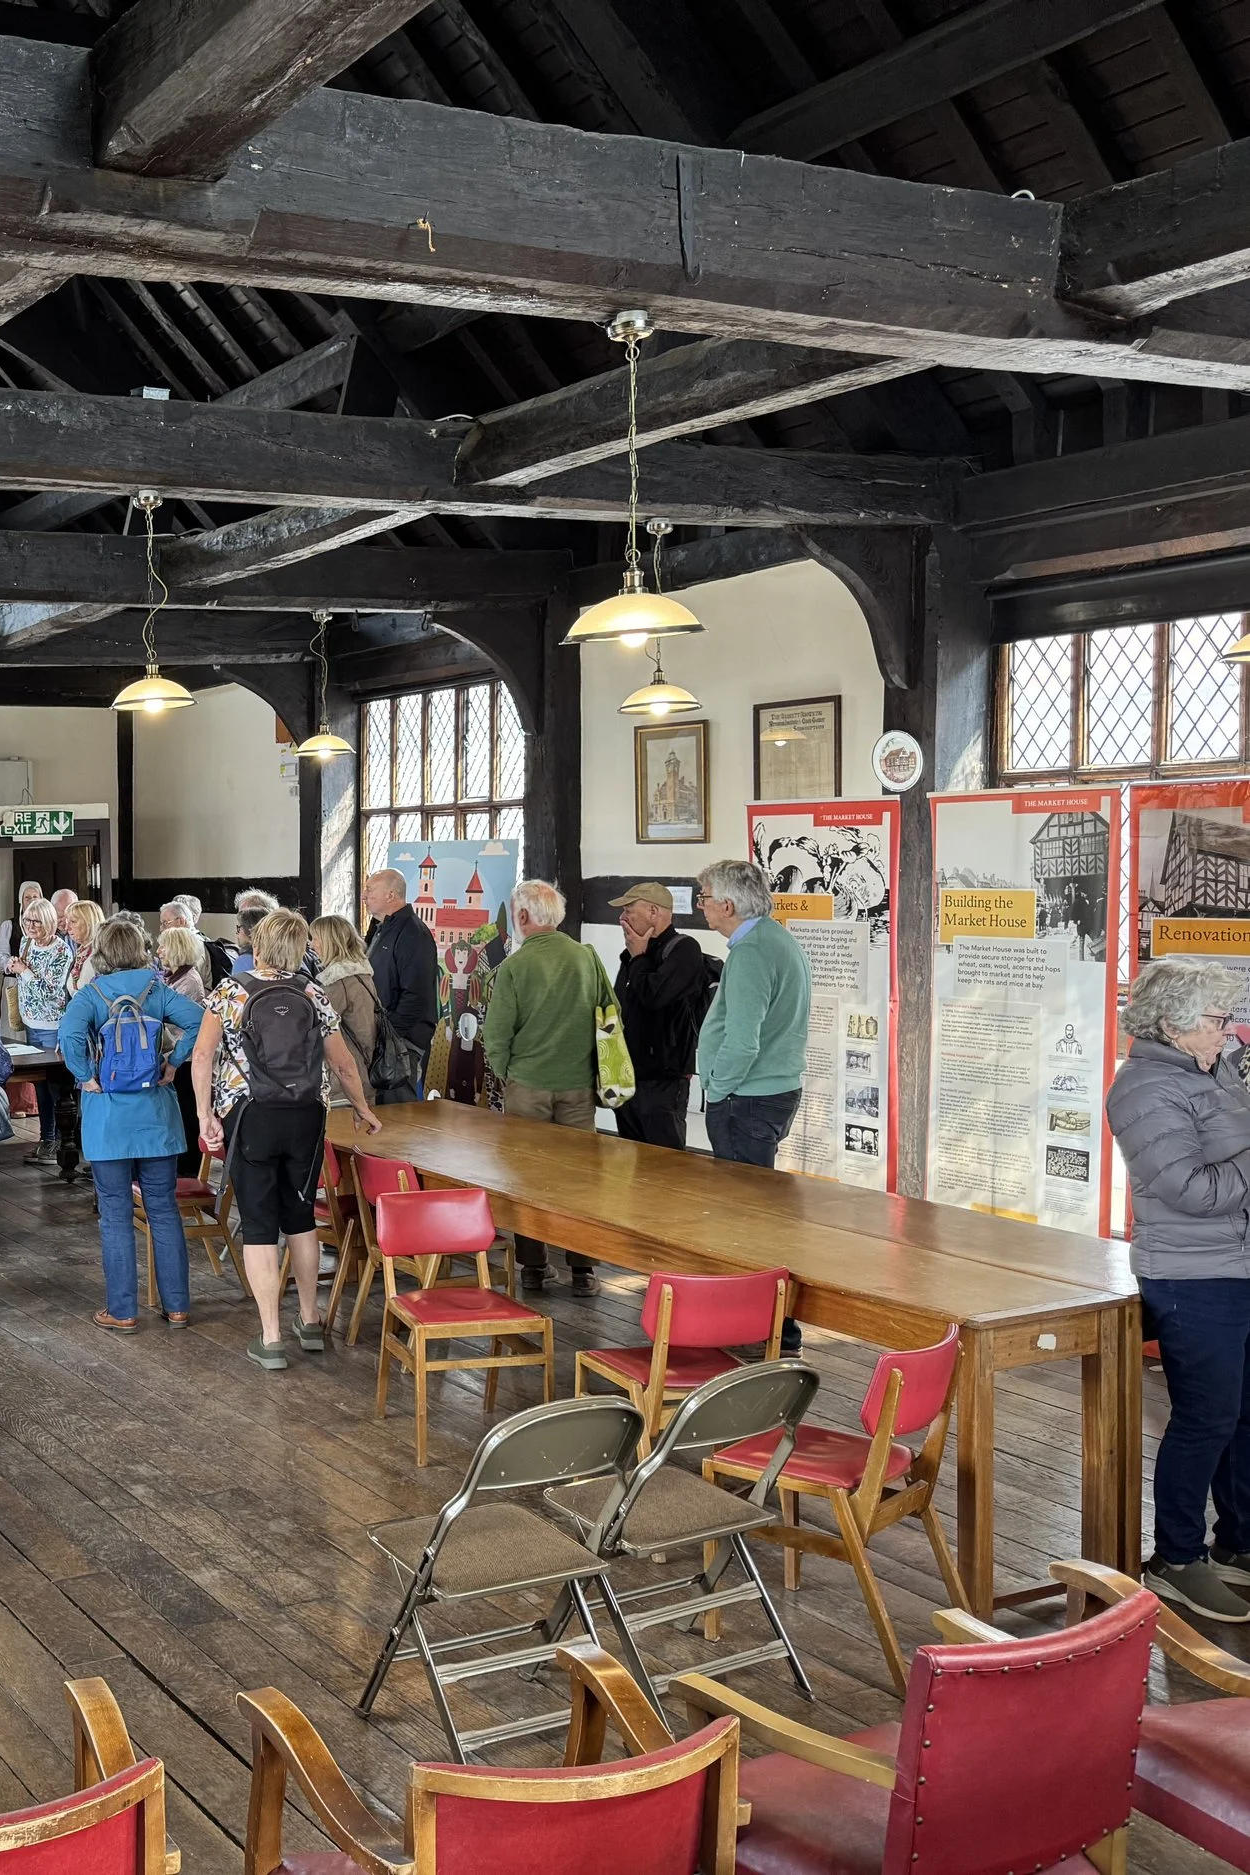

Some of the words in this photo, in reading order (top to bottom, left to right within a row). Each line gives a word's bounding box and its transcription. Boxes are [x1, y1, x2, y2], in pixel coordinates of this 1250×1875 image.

[15, 812, 32, 823] RE
[4, 824, 32, 834] EXIT
[773, 899, 798, 911] rkets
[800, 899, 809, 911] &
[944, 895, 992, 912] Building
[994, 896, 1013, 909] the
[944, 913, 987, 927] Market
[989, 914, 1027, 928] House
[958, 952, 980, 960] provide
[1001, 955, 1025, 963] storage
[820, 966, 843, 974] travelling
[958, 961, 978, 969] wheat,
[1045, 965, 1061, 974] hops
[957, 968, 981, 977] brought
[1032, 973, 1046, 982] help
[845, 982, 860, 990] trade.
[957, 977, 972, 985] keep
[983, 978, 995, 986] rats
[996, 979, 1007, 987] and
[1008, 980, 1024, 988] mice
[1031, 982, 1044, 990] bay.
